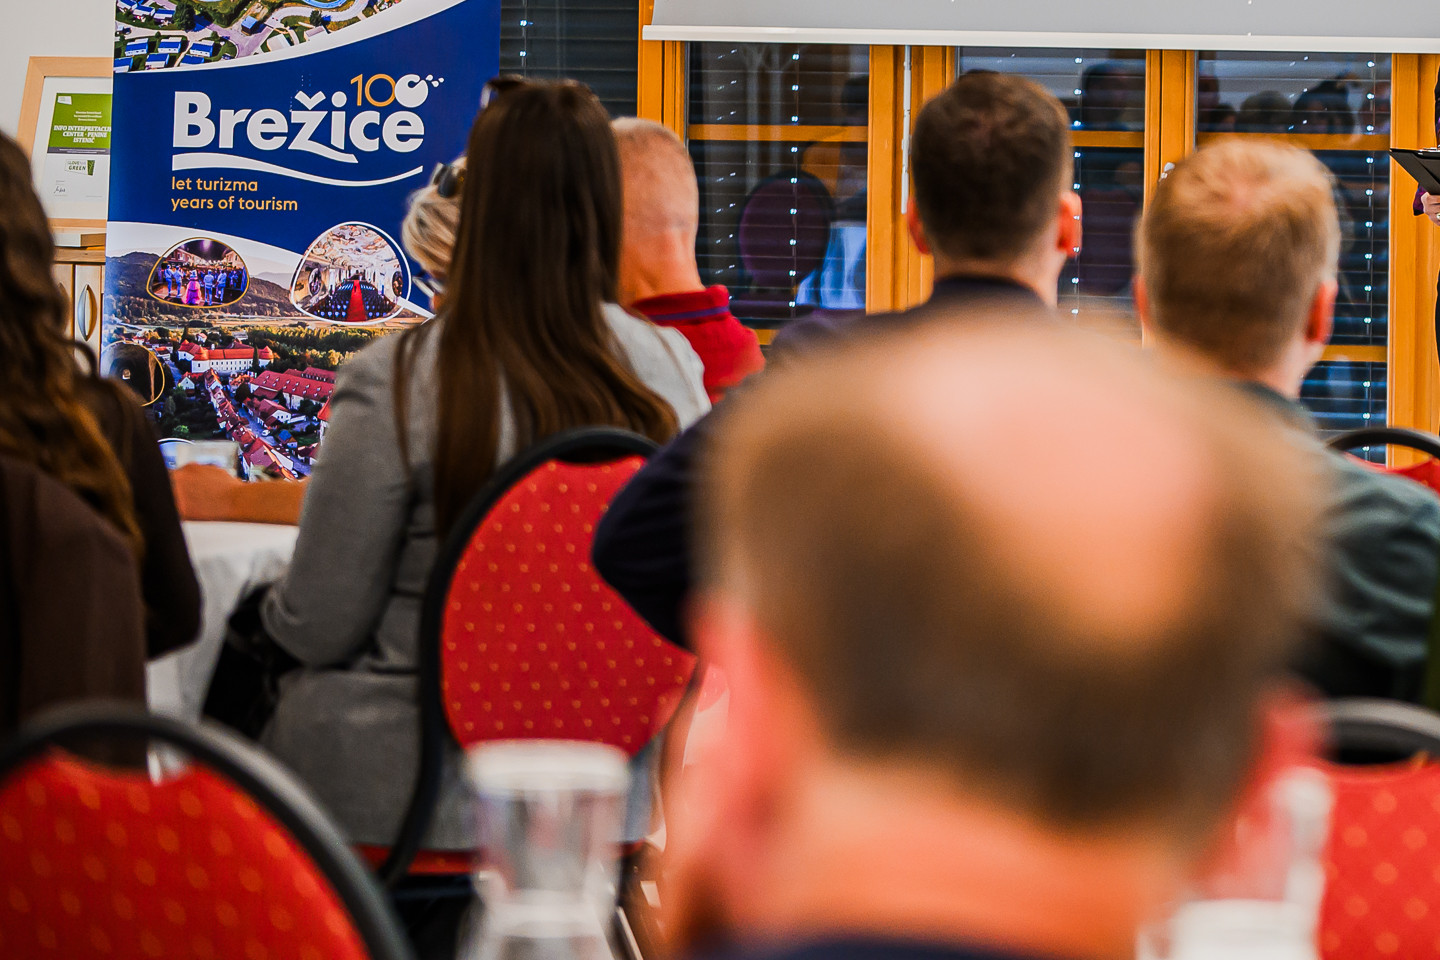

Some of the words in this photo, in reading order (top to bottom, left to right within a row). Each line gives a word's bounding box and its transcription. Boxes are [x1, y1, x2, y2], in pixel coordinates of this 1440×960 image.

[172, 90, 426, 164] Brežice
[171, 176, 192, 191] let
[196, 176, 258, 192] turizma
[171, 197, 214, 212] years
[218, 196, 235, 210] of
[241, 197, 299, 211] tourism
